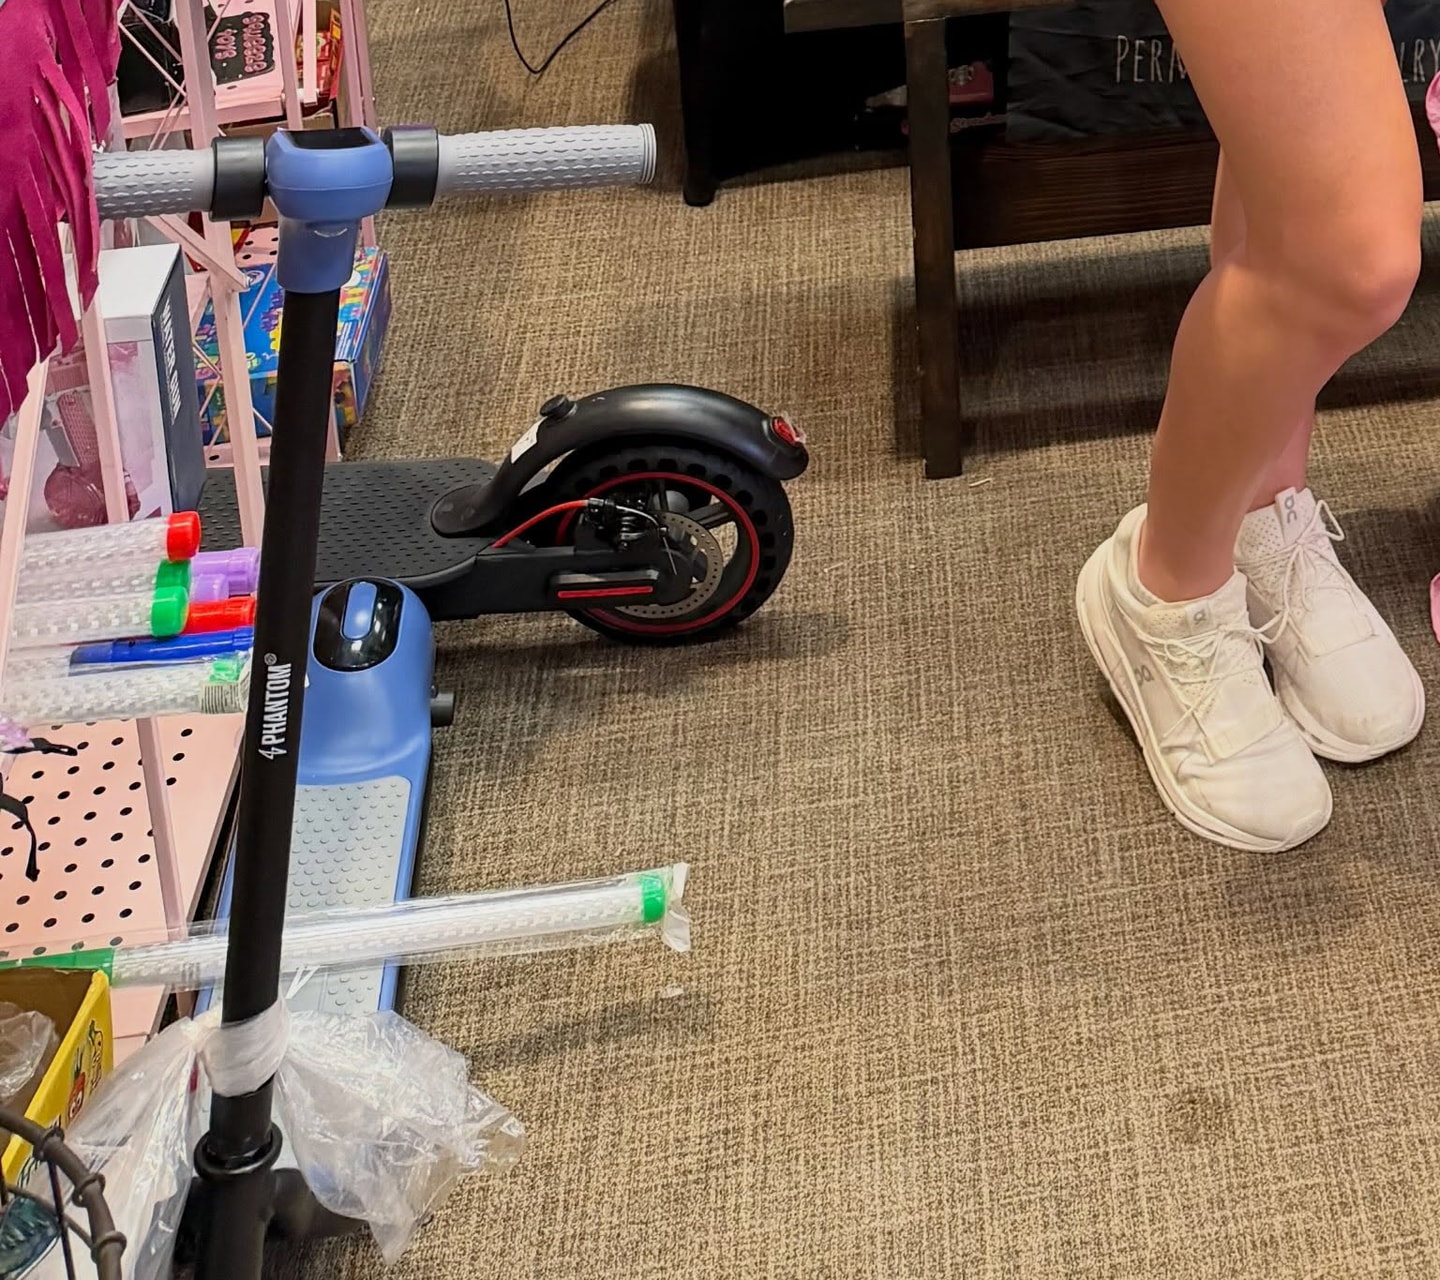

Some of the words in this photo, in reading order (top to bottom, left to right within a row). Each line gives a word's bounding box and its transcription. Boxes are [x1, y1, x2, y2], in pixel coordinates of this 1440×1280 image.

[214, 27, 237, 60] TOYS
[242, 13, 267, 73] SQUEEZE
[160, 296, 177, 375] WATER
[169, 369, 182, 423] GUN
[261, 662, 292, 746] PHANTOM
